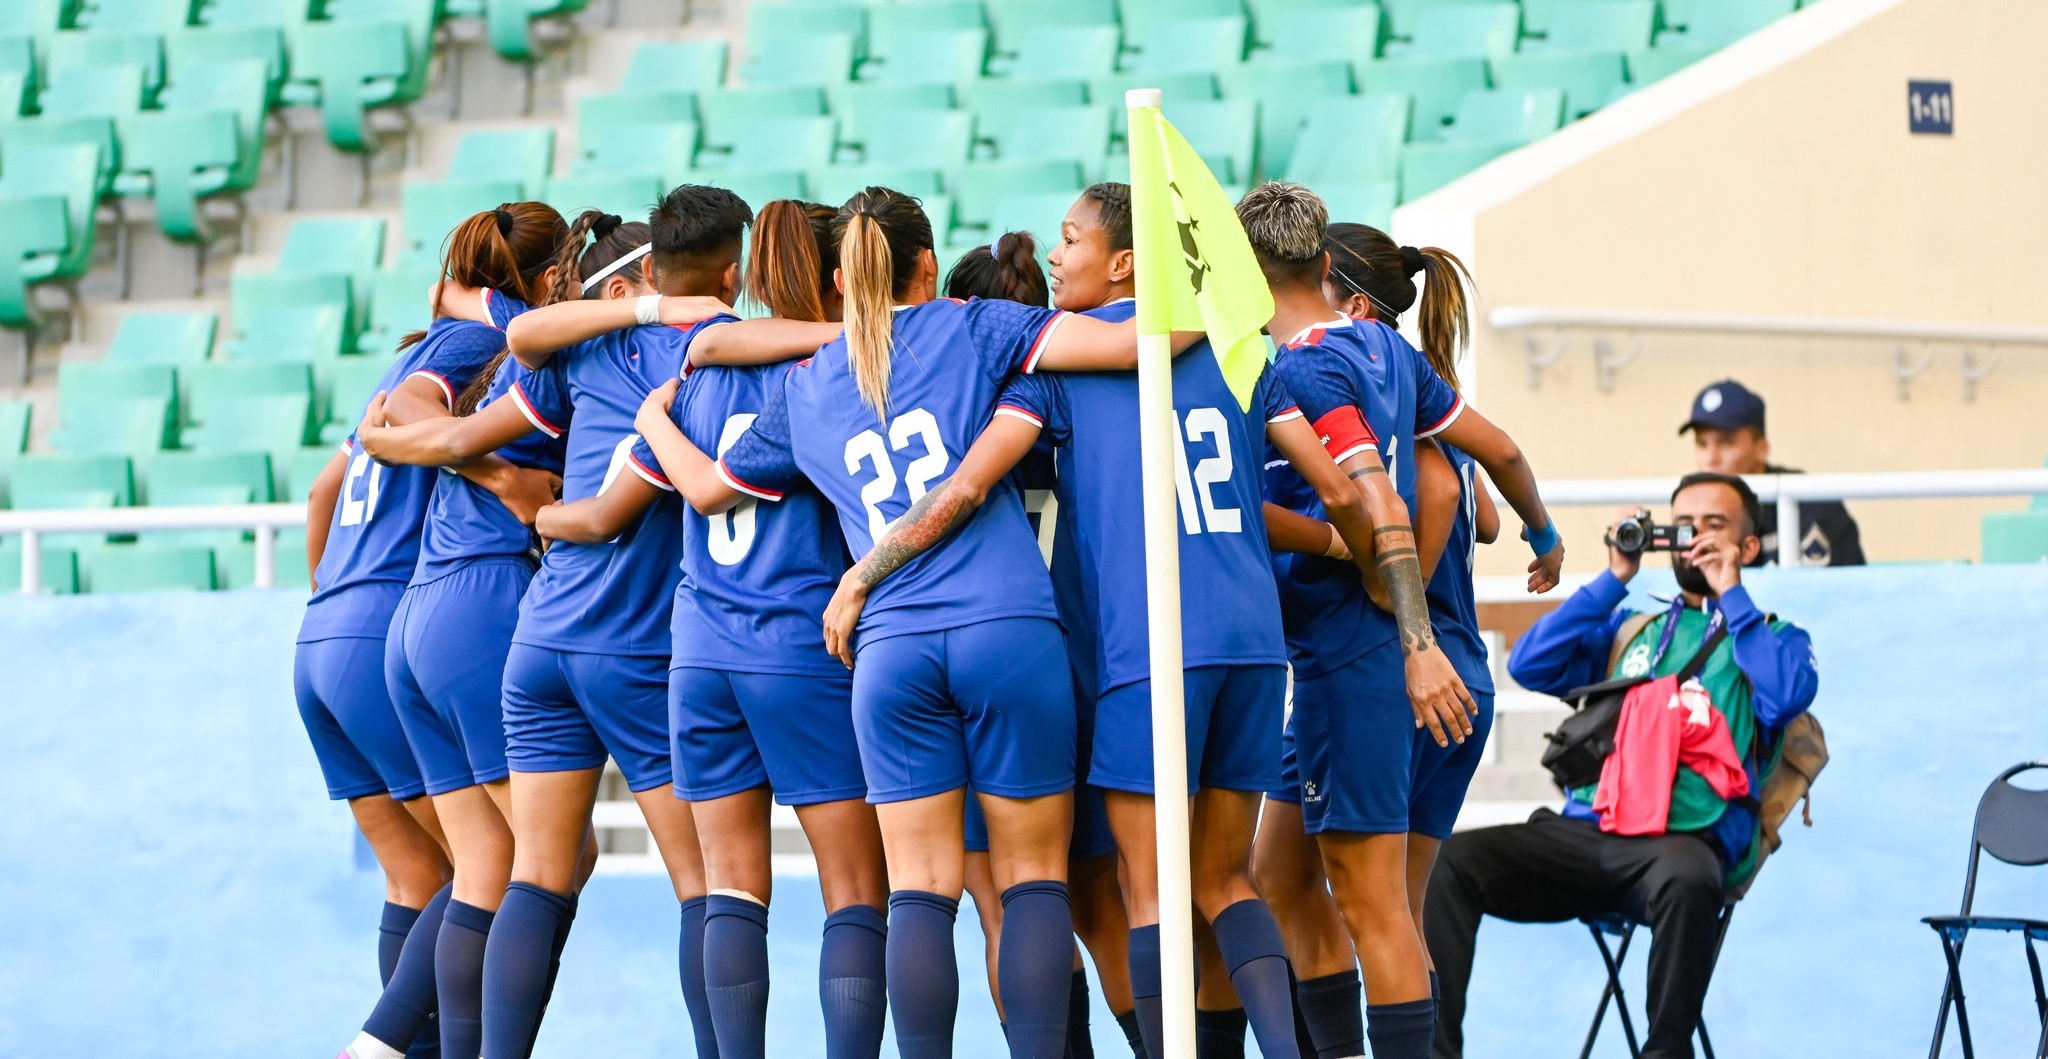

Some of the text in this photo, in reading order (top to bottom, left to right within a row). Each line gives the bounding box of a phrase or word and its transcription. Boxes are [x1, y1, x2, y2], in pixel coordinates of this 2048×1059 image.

[1911, 91, 1951, 123] 1-11
[340, 450, 382, 527] 21
[844, 408, 949, 544] 22
[1172, 407, 1242, 535] 12
